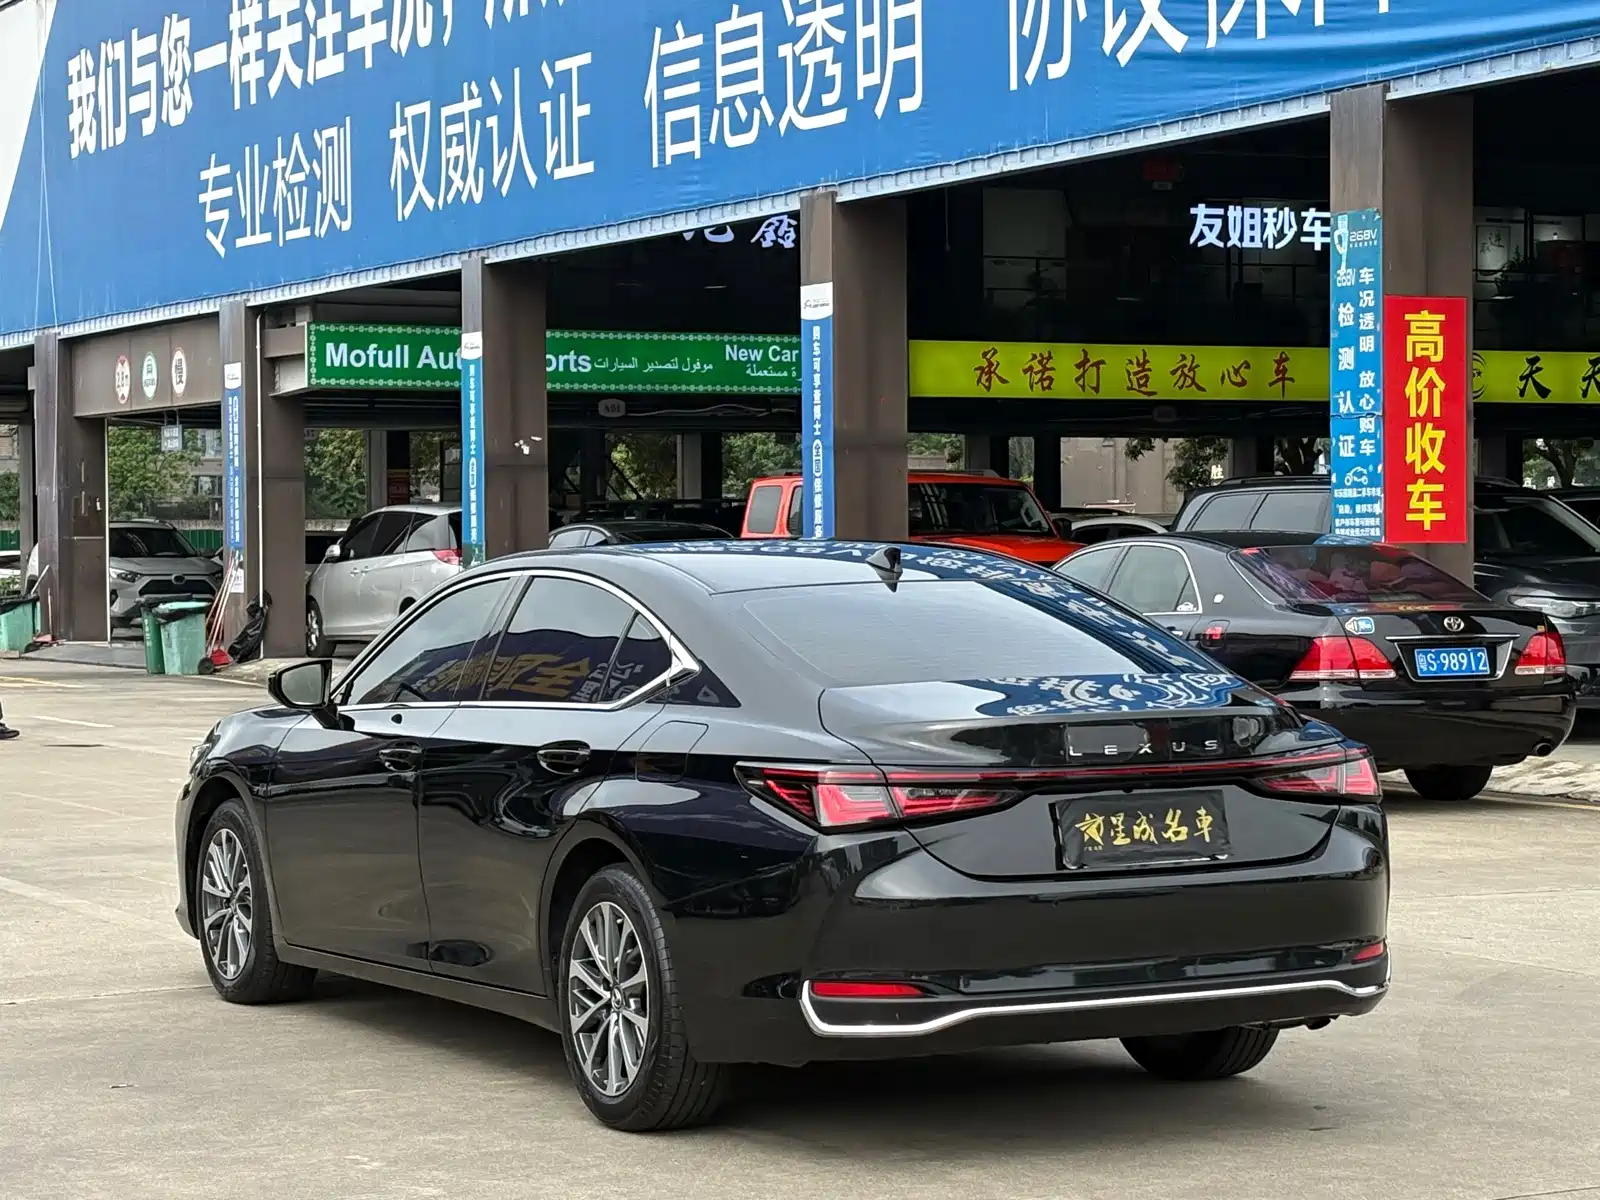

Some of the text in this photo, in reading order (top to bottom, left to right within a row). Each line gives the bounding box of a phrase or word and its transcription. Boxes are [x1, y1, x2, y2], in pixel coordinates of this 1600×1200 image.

[199, 117, 352, 258] 专业检测
[390, 52, 594, 222] 权威认证
[643, 0, 924, 168] 信息透明
[1190, 203, 1330, 252] 友姐秒车
[1349, 228, 1378, 242] 268V
[1358, 267, 1375, 353] 车况透明
[325, 343, 592, 373] Mofull Aut orts
[593, 357, 714, 373] موفول لتصدير السيارات
[725, 344, 763, 362] New
[745, 363, 788, 378] مستعملة
[973, 347, 1296, 400] 承诺打造放心车
[1337, 302, 1356, 458] 检测认证
[1358, 370, 1376, 457] 放心购车
[1404, 310, 1447, 531] 高价收车
[1069, 739, 1219, 757] LEXUS
